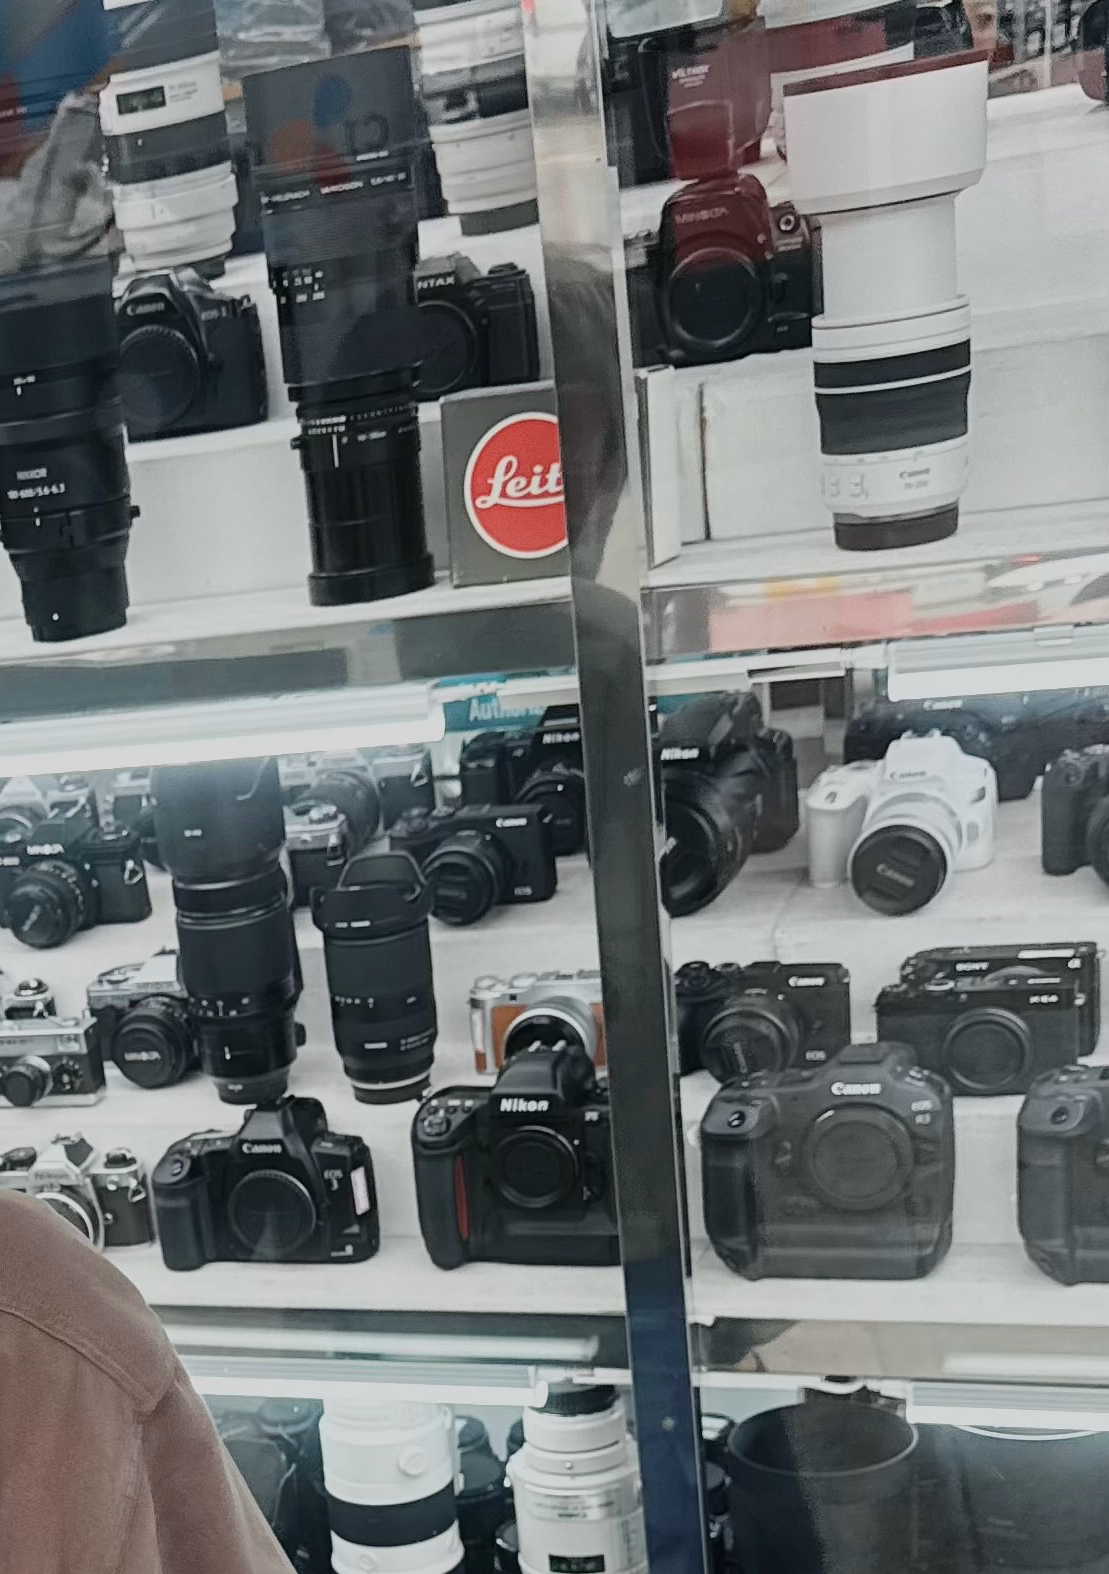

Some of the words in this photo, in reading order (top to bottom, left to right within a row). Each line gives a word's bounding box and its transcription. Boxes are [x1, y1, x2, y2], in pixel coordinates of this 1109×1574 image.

[417, 275, 456, 290] NTAX
[126, 301, 165, 317] Canon
[474, 455, 565, 509] Leit
[542, 731, 581, 745] Nikon
[660, 747, 700, 761] Nikon
[495, 817, 528, 828] Canon
[955, 961, 990, 971] SONY
[788, 976, 826, 988] Canon
[830, 1080, 882, 1096] Canon
[498, 1097, 550, 1113] Nikon
[241, 1142, 283, 1155] Canon
